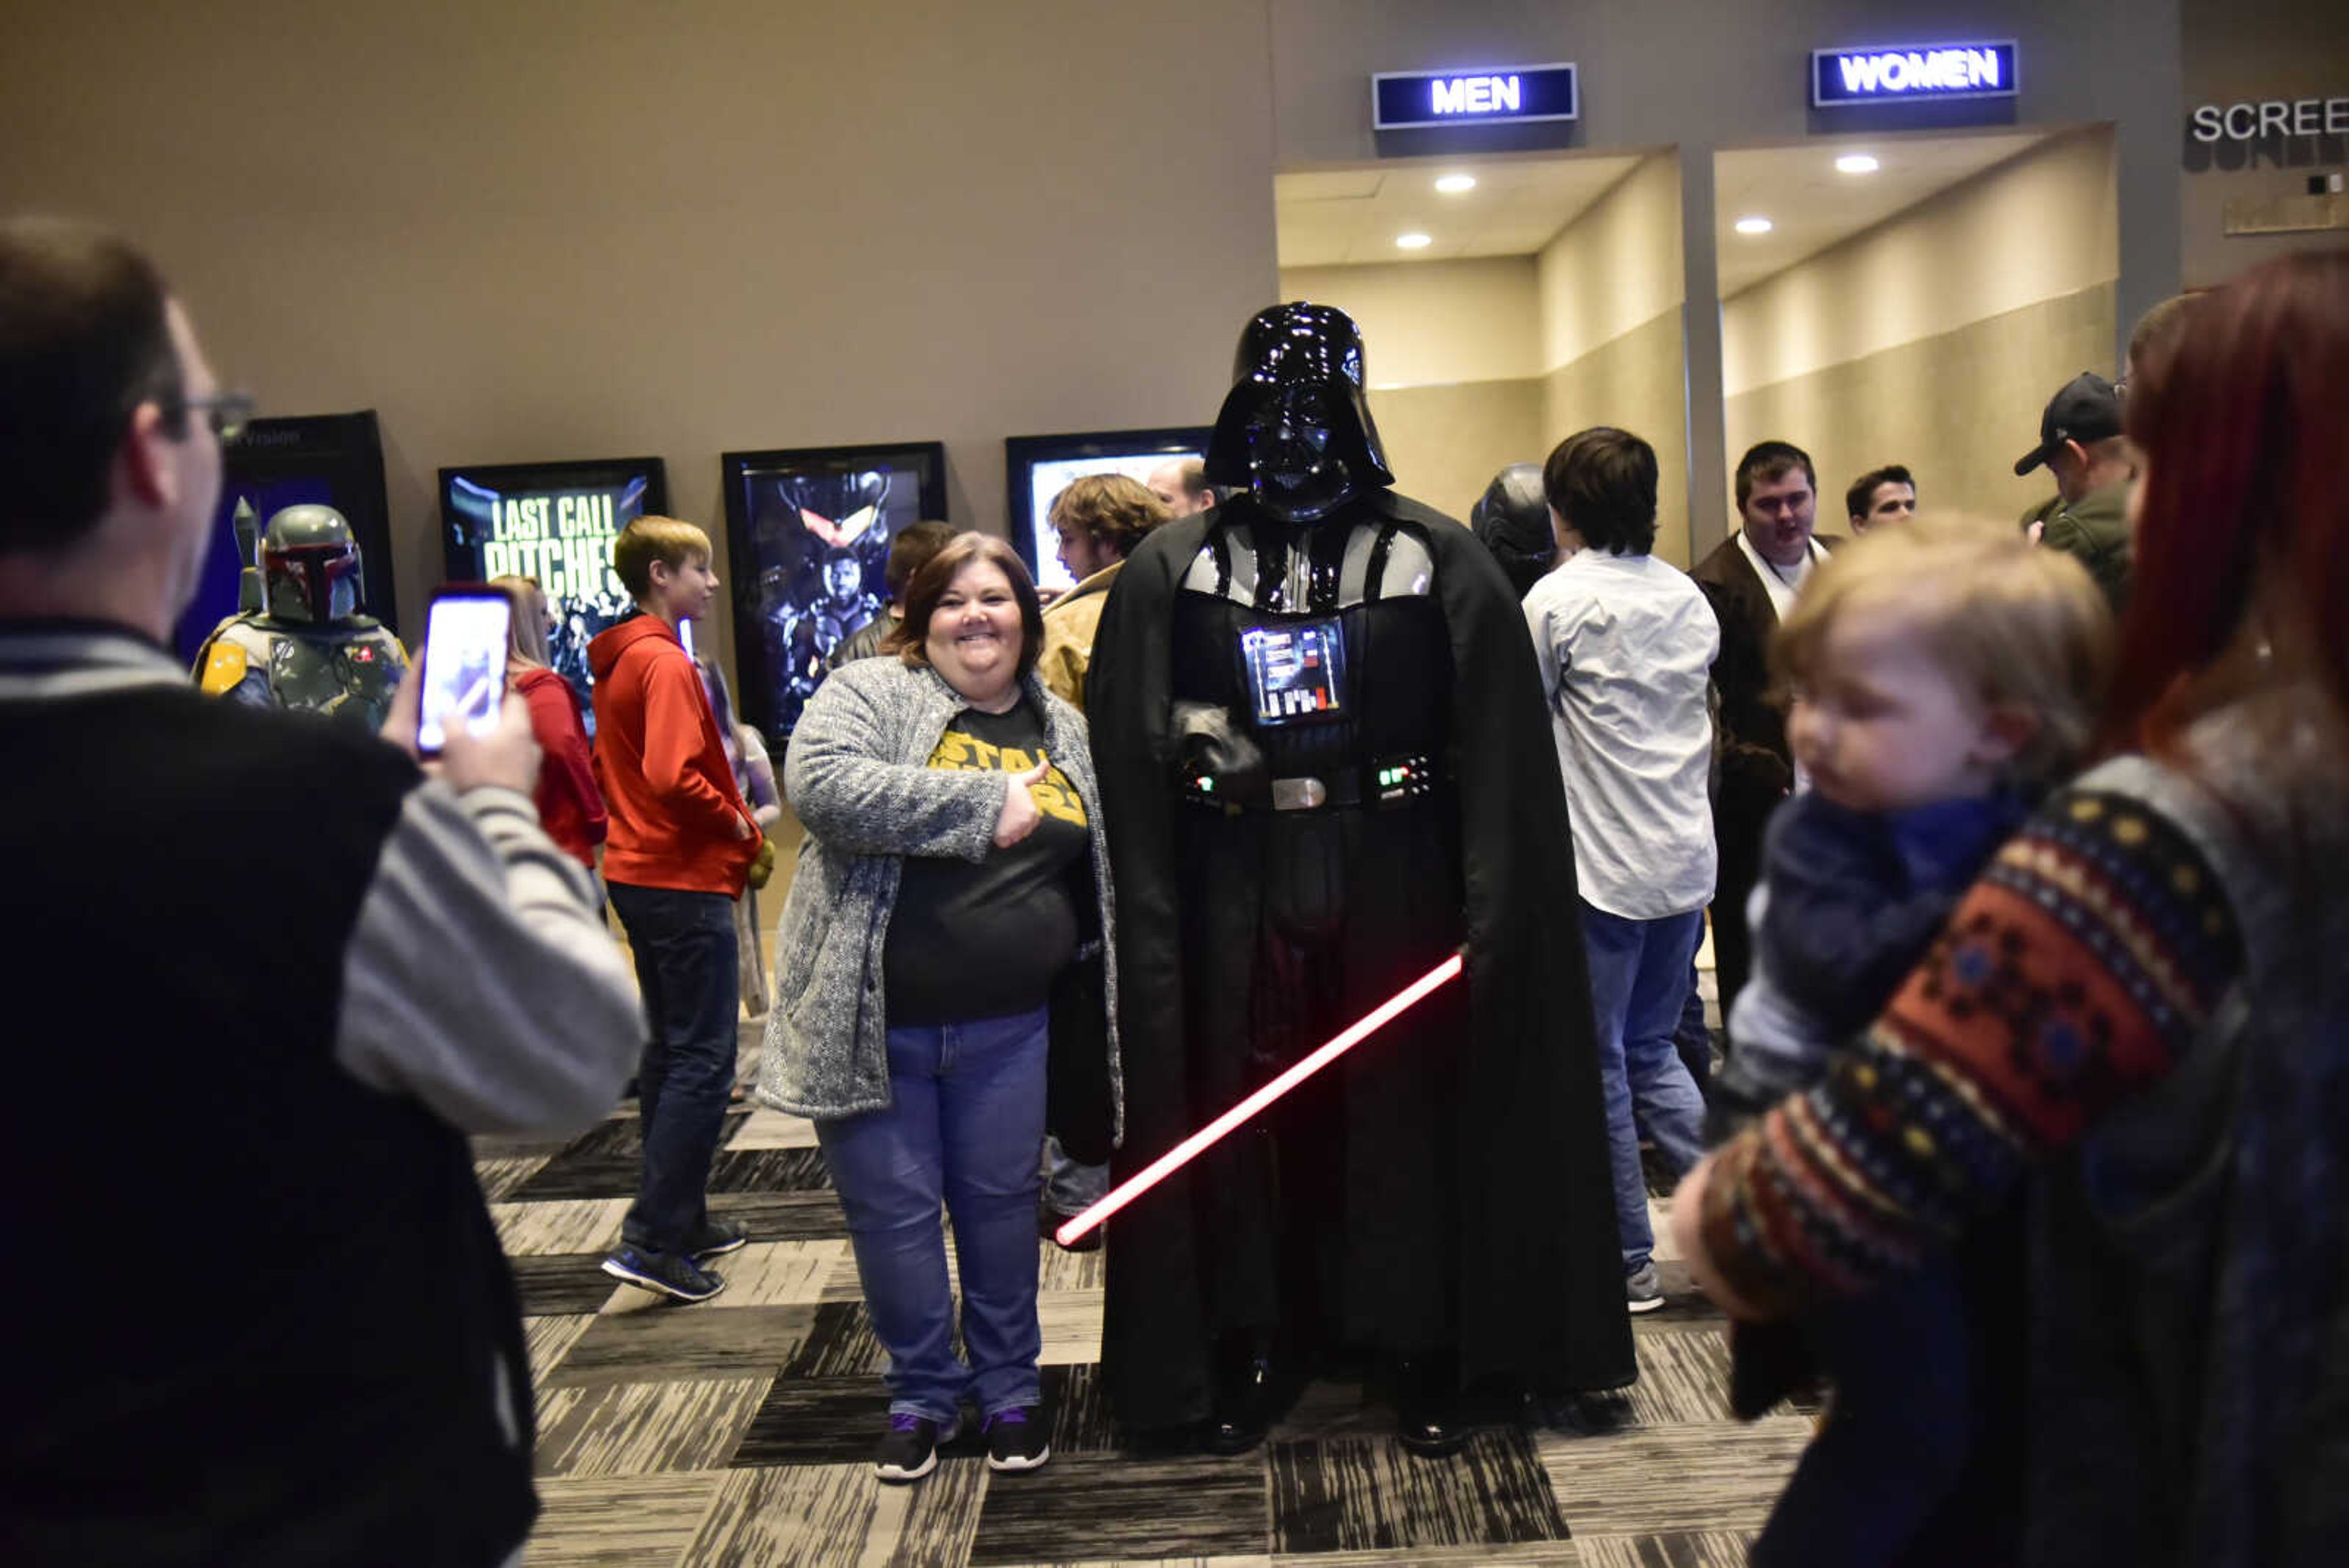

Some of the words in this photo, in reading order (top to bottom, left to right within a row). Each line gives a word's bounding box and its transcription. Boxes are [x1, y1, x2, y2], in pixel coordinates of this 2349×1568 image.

[1839, 47, 1999, 91] WOMEN
[1431, 76, 1521, 114] MEN
[2193, 98, 2349, 141] SCREE
[492, 497, 551, 541] LAST
[557, 493, 617, 538] CALL
